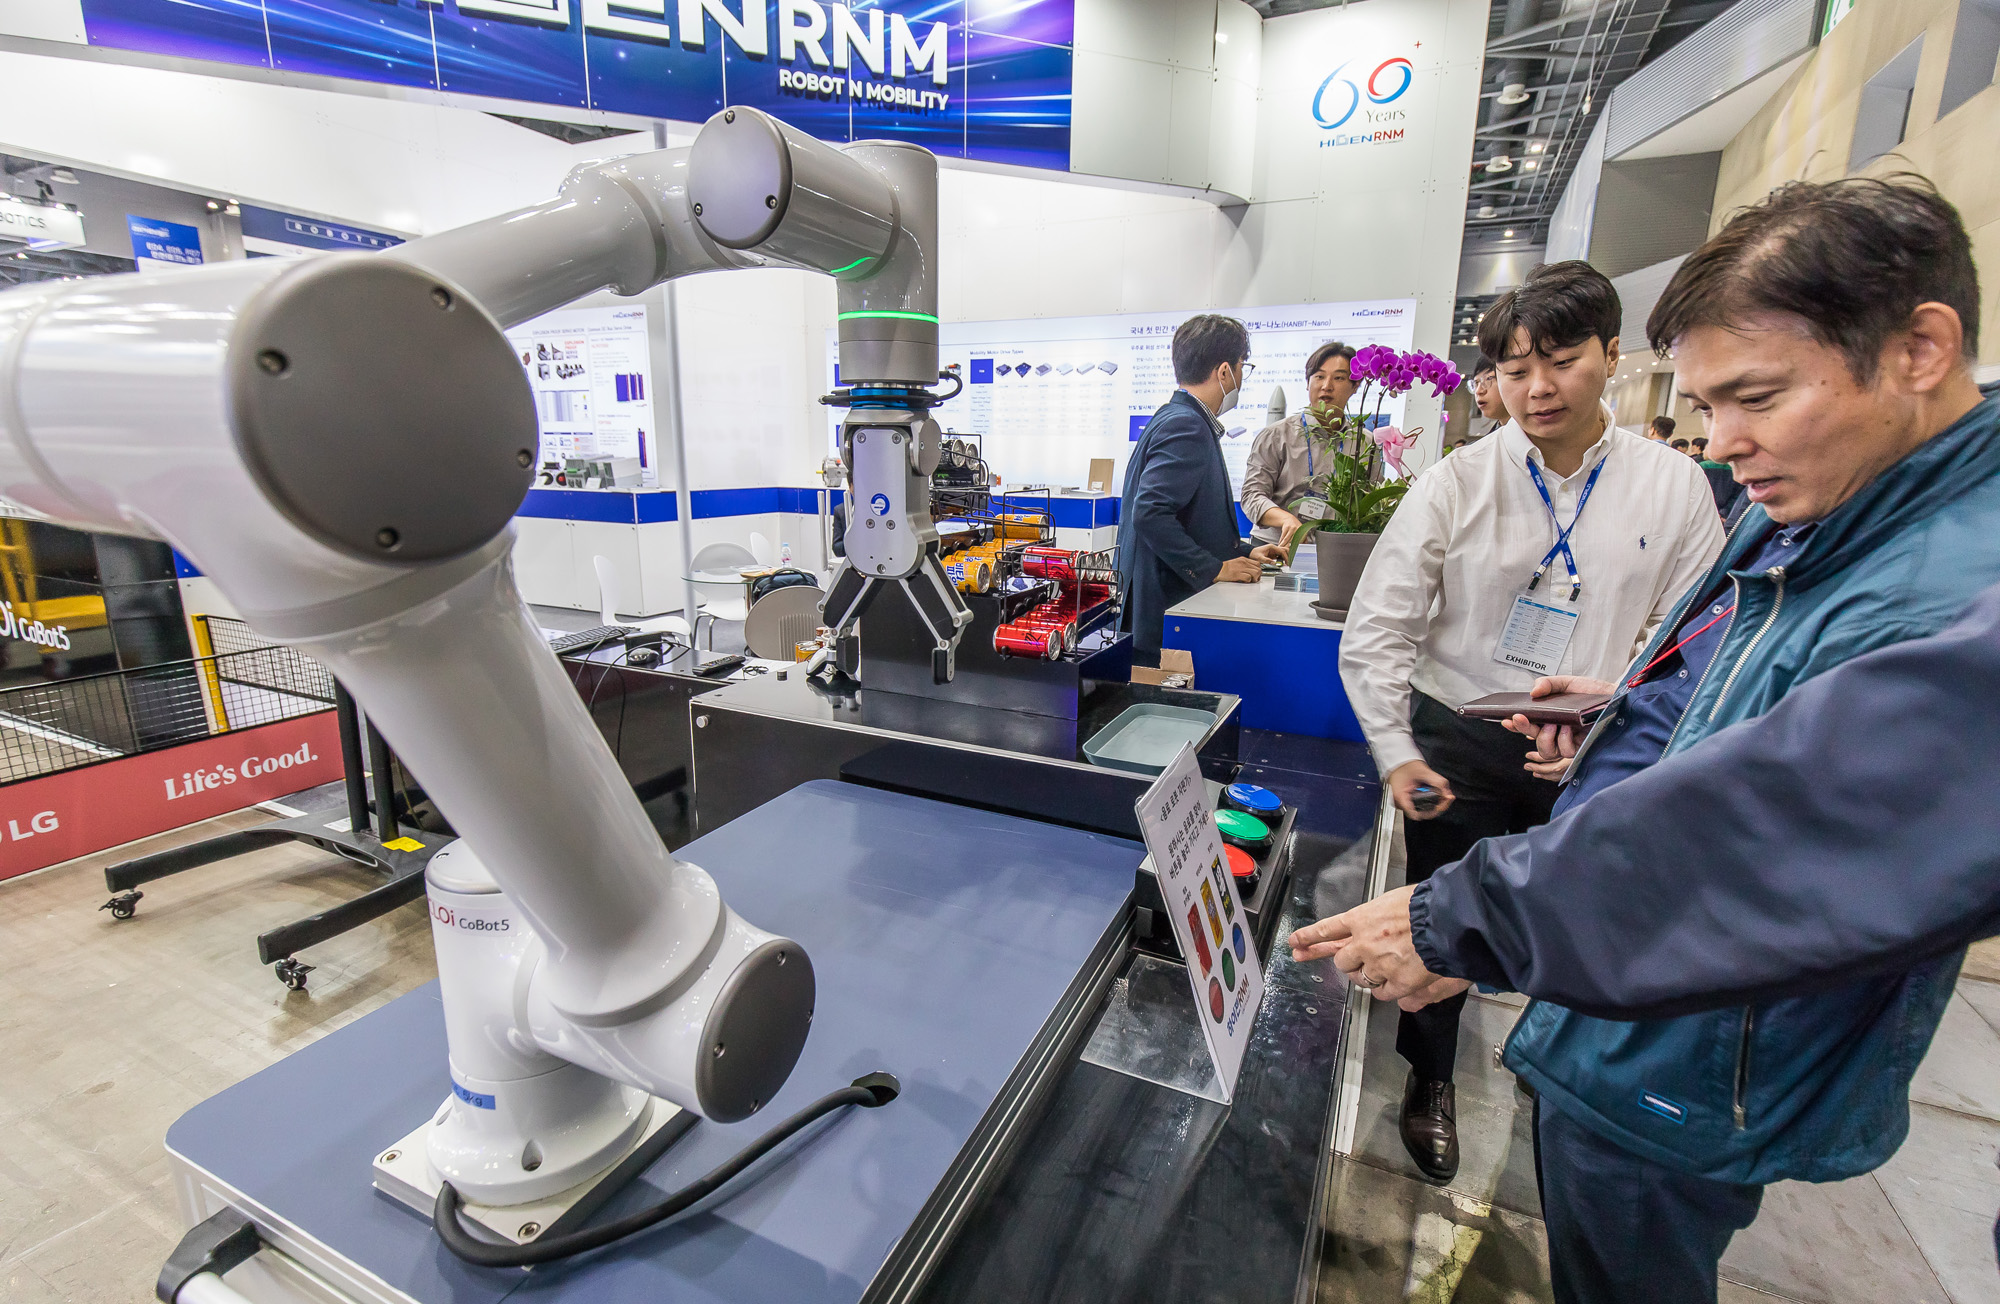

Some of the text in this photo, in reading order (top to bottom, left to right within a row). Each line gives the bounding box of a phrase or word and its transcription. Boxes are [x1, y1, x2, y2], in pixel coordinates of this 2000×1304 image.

[779, 68, 949, 111] ROBOT N MOBILITY
[1366, 109, 1406, 123] Years
[1505, 654, 1547, 671] EXHIBITOR
[164, 742, 319, 801] Life's Good.
[9, 811, 60, 842] LG
